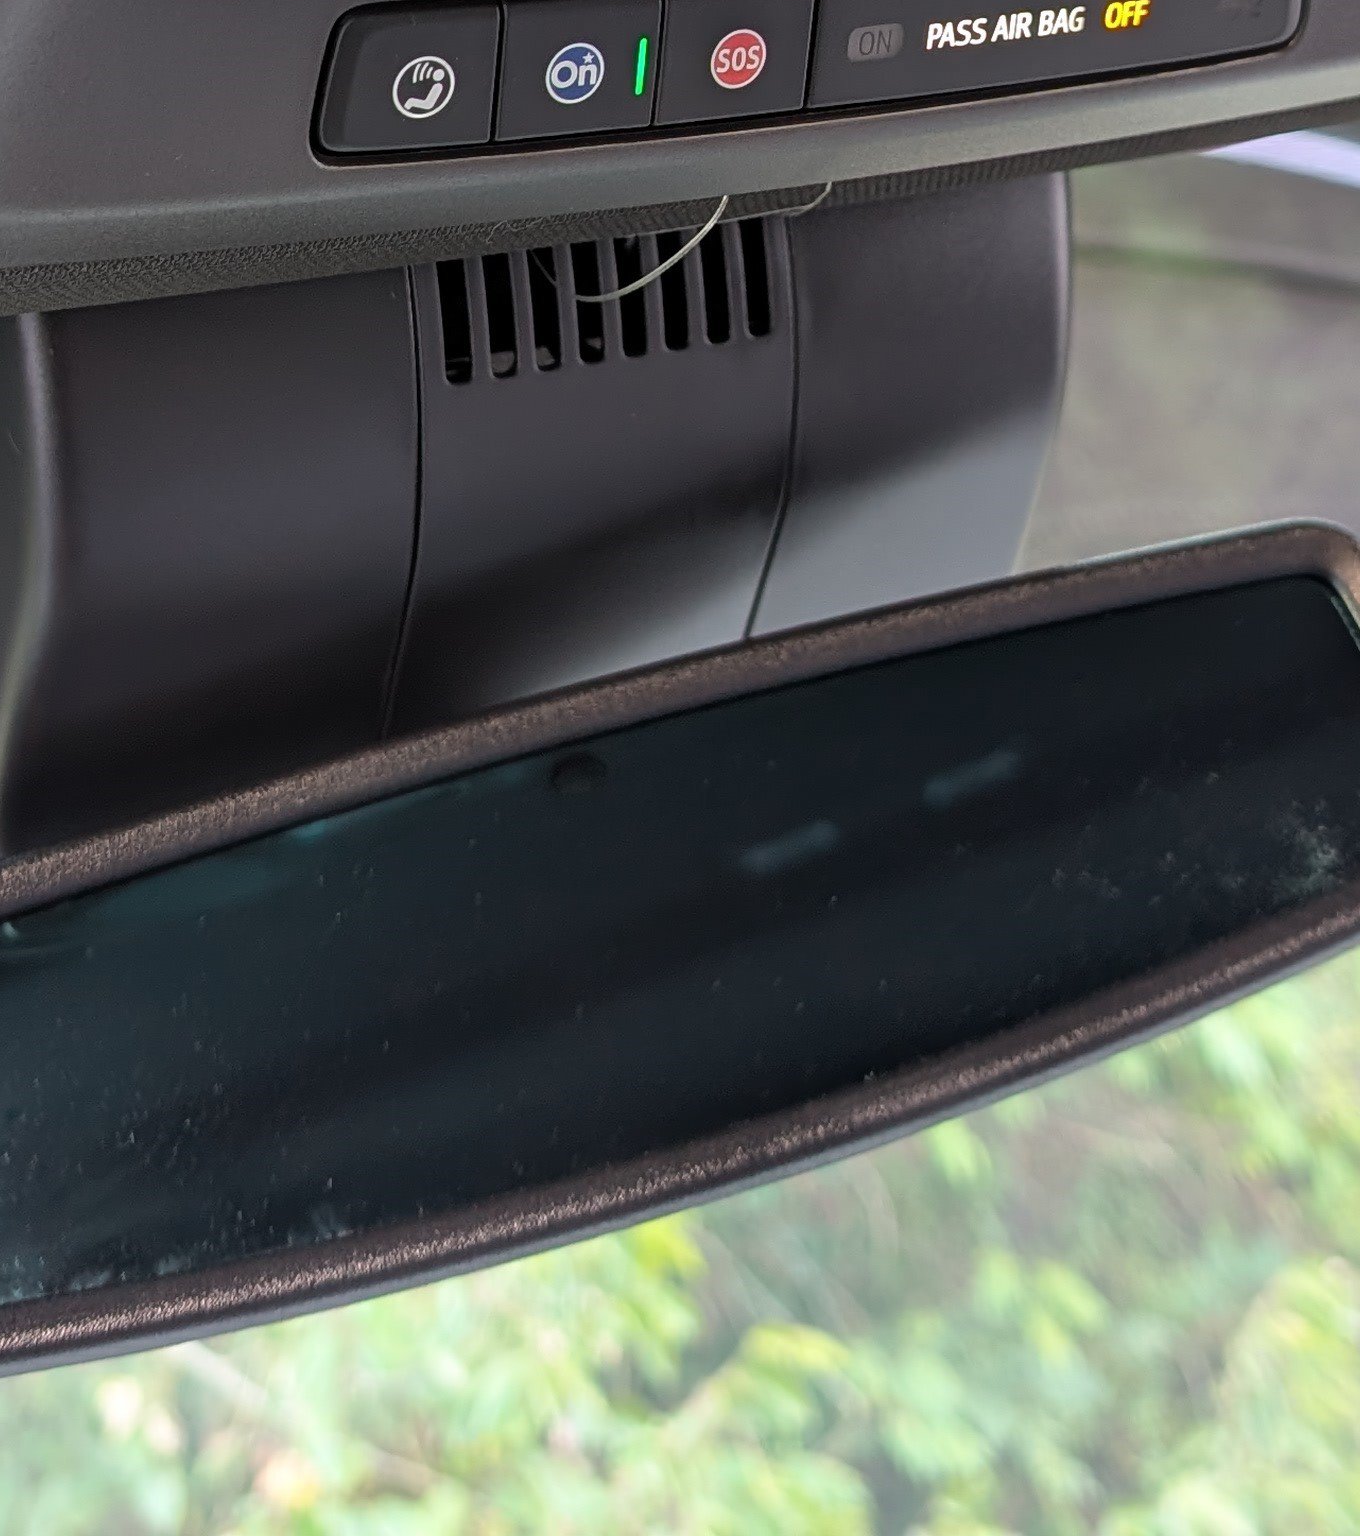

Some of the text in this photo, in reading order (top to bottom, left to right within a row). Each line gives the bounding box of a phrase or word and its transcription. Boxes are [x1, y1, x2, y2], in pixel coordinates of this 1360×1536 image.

[925, 17, 988, 50] PASS
[990, 11, 1033, 44] AIR
[1037, 5, 1087, 38] BAG
[858, 30, 893, 57] ON
[550, 59, 598, 89] On
[715, 45, 761, 74] SOS
